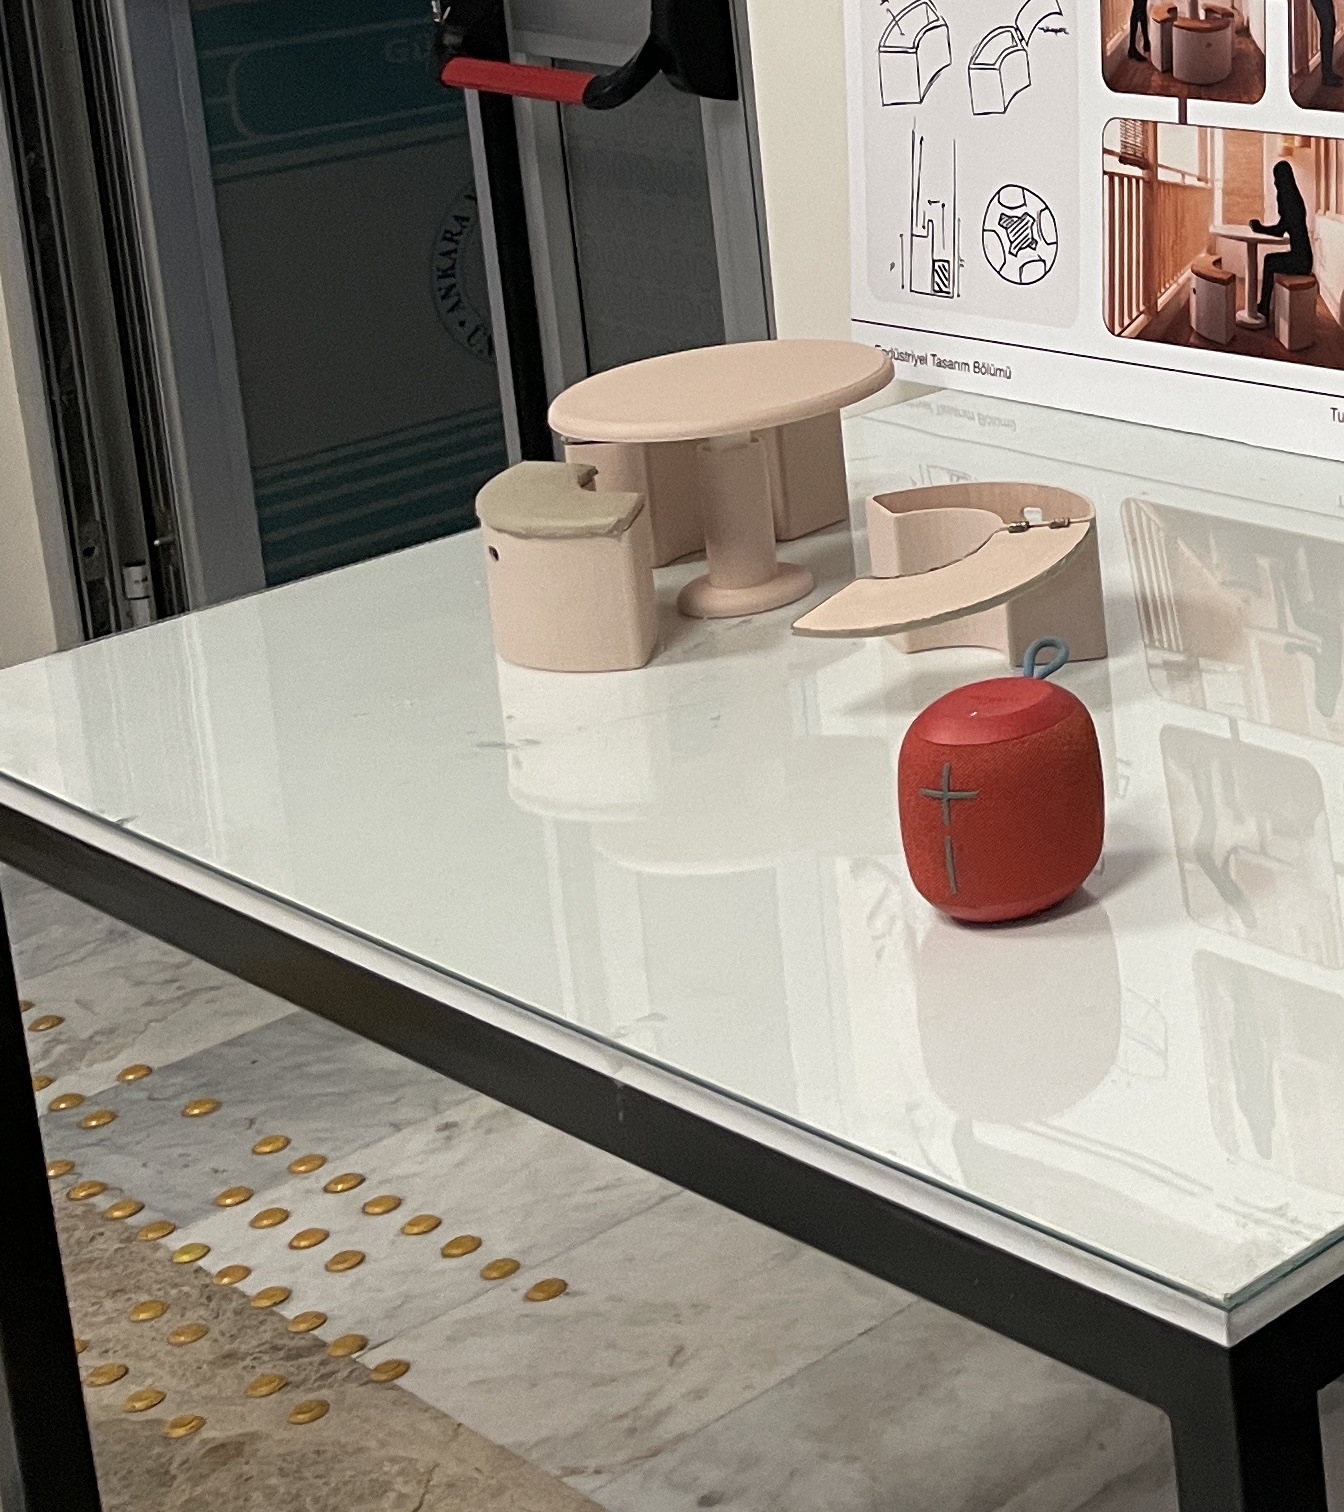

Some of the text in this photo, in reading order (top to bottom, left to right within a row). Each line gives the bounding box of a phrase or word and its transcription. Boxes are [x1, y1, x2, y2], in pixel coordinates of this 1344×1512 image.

[875, 344, 1012, 379] düstriyel Tasarım Bölümü
